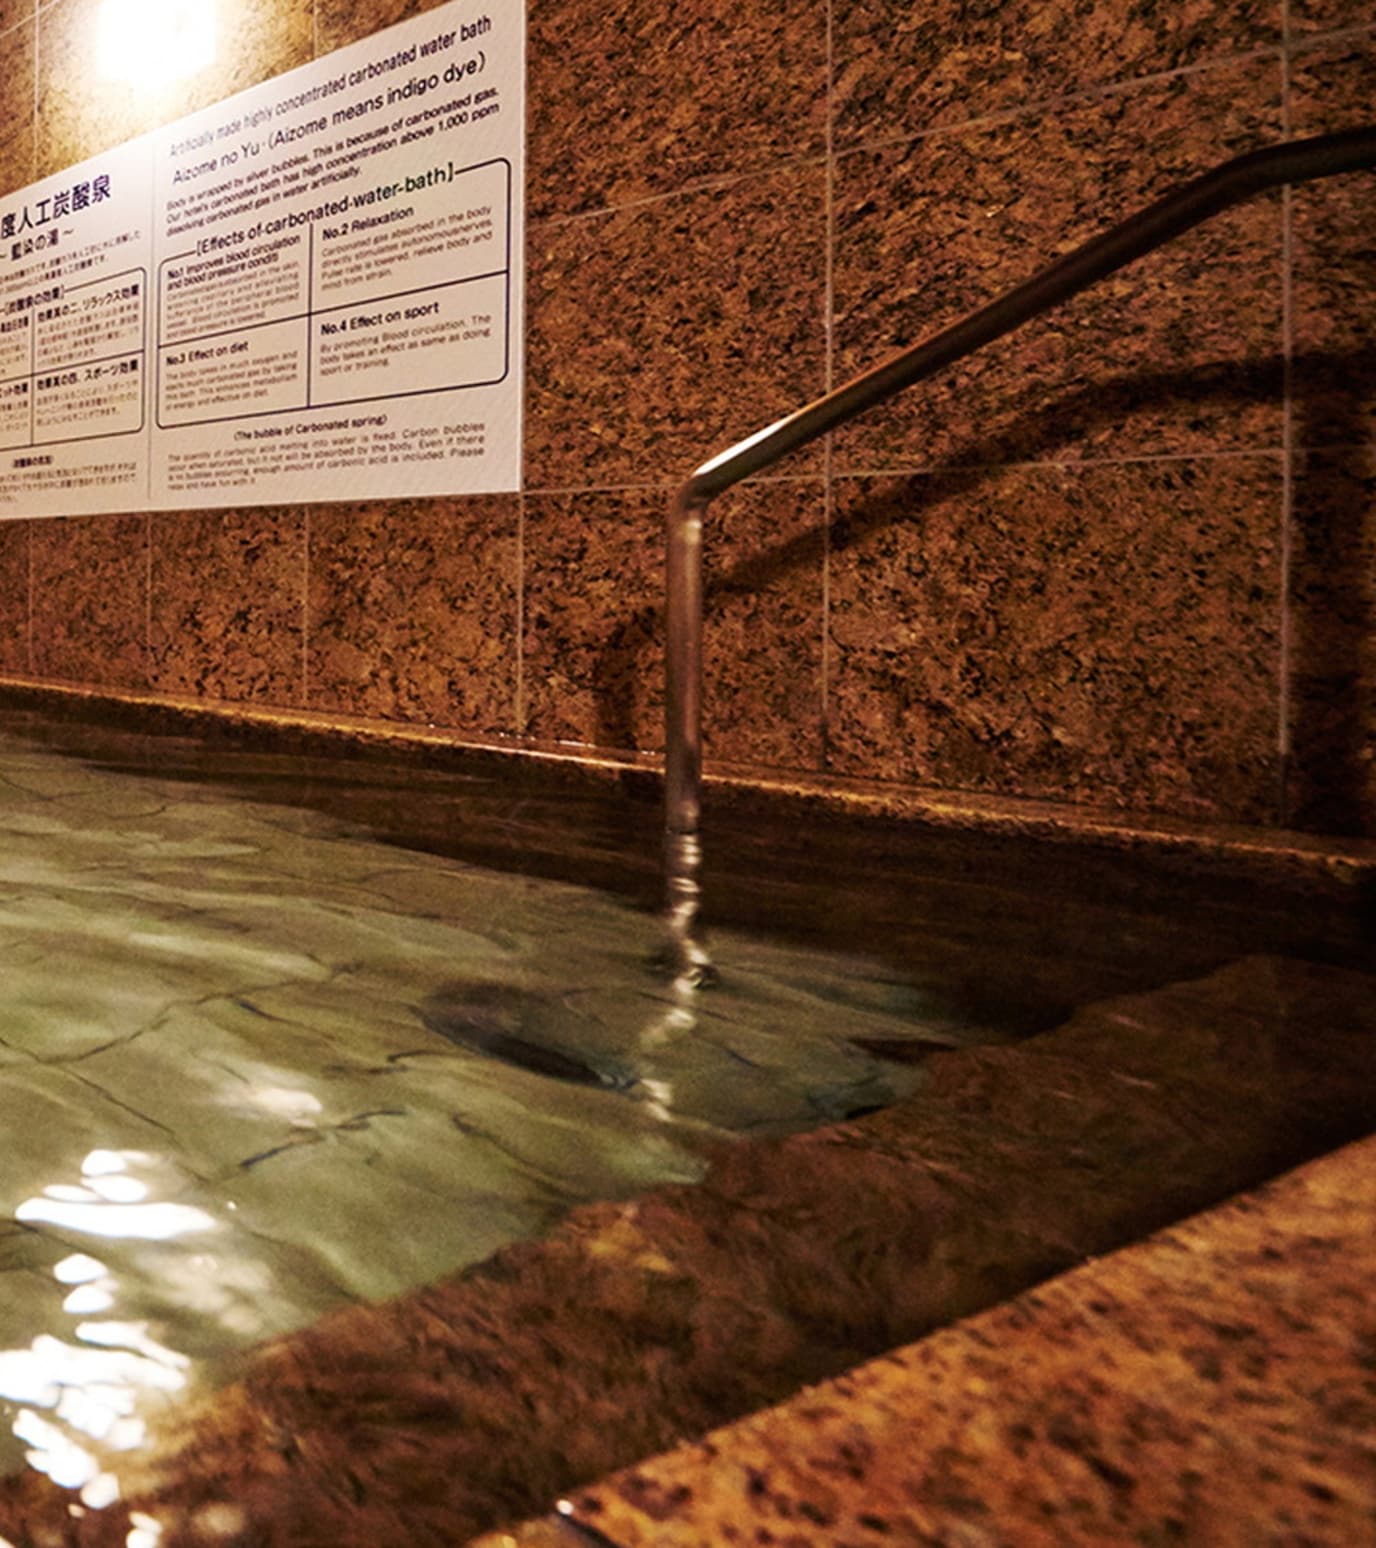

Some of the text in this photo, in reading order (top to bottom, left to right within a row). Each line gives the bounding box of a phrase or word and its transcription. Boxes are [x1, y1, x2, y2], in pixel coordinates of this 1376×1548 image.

[217, 119, 240, 138] made
[244, 106, 270, 128] highly
[276, 73, 345, 115] concentrated
[349, 44, 416, 86] carbonated
[420, 31, 455, 57] water
[460, 15, 490, 41] bath
[173, 158, 216, 184] Aizome
[221, 151, 237, 166] no
[332, 95, 382, 124] means
[387, 74, 438, 104] indigo
[443, 51, 485, 83] dye)
[166, 212, 180, 223] Our
[210, 184, 257, 208] carbonated
[260, 177, 280, 191] bath
[283, 172, 299, 183] has
[302, 162, 323, 176] high
[326, 138, 396, 169] concentration
[400, 125, 434, 144] above
[438, 112, 468, 130] 1,000
[471, 104, 499, 121] ppm
[197, 180, 231, 199] wrapped
[234, 178, 242, 187] by
[246, 167, 268, 182] silver
[313, 145, 331, 157] This
[335, 142, 343, 150] is
[346, 125, 388, 147] because
[391, 119, 403, 131] of
[405, 95, 470, 126] carbonated
[166, 218, 203, 236] dissolving
[206, 200, 253, 223] carbonated
[255, 196, 270, 209] gas
[272, 192, 280, 201] in
[283, 183, 307, 198] water
[322, 206, 413, 239] No.2 Relaxation
[321, 206, 491, 257] Carbonated gas absorbed in the body
[413, 243, 443, 256] relieve
[447, 237, 469, 249] body
[473, 230, 492, 243] and
[226, 248, 249, 263] blood
[251, 234, 300, 256] circulation
[167, 279, 181, 290] and
[184, 272, 205, 286] blood
[208, 263, 245, 280] pressure
[321, 301, 439, 334] No.4 Effect on sport
[334, 335, 378, 351] promoting
[382, 329, 408, 341] Blood
[471, 314, 491, 324] The
[188, 348, 213, 361] Effect
[216, 347, 226, 356] on
[230, 341, 247, 353] diet
[380, 342, 404, 353] effect
[408, 341, 417, 349] as
[421, 336, 445, 346] same
[462, 327, 490, 340] doing
[254, 428, 282, 437] bubble
[284, 425, 293, 434] of
[295, 419, 347, 433] Carbonated
